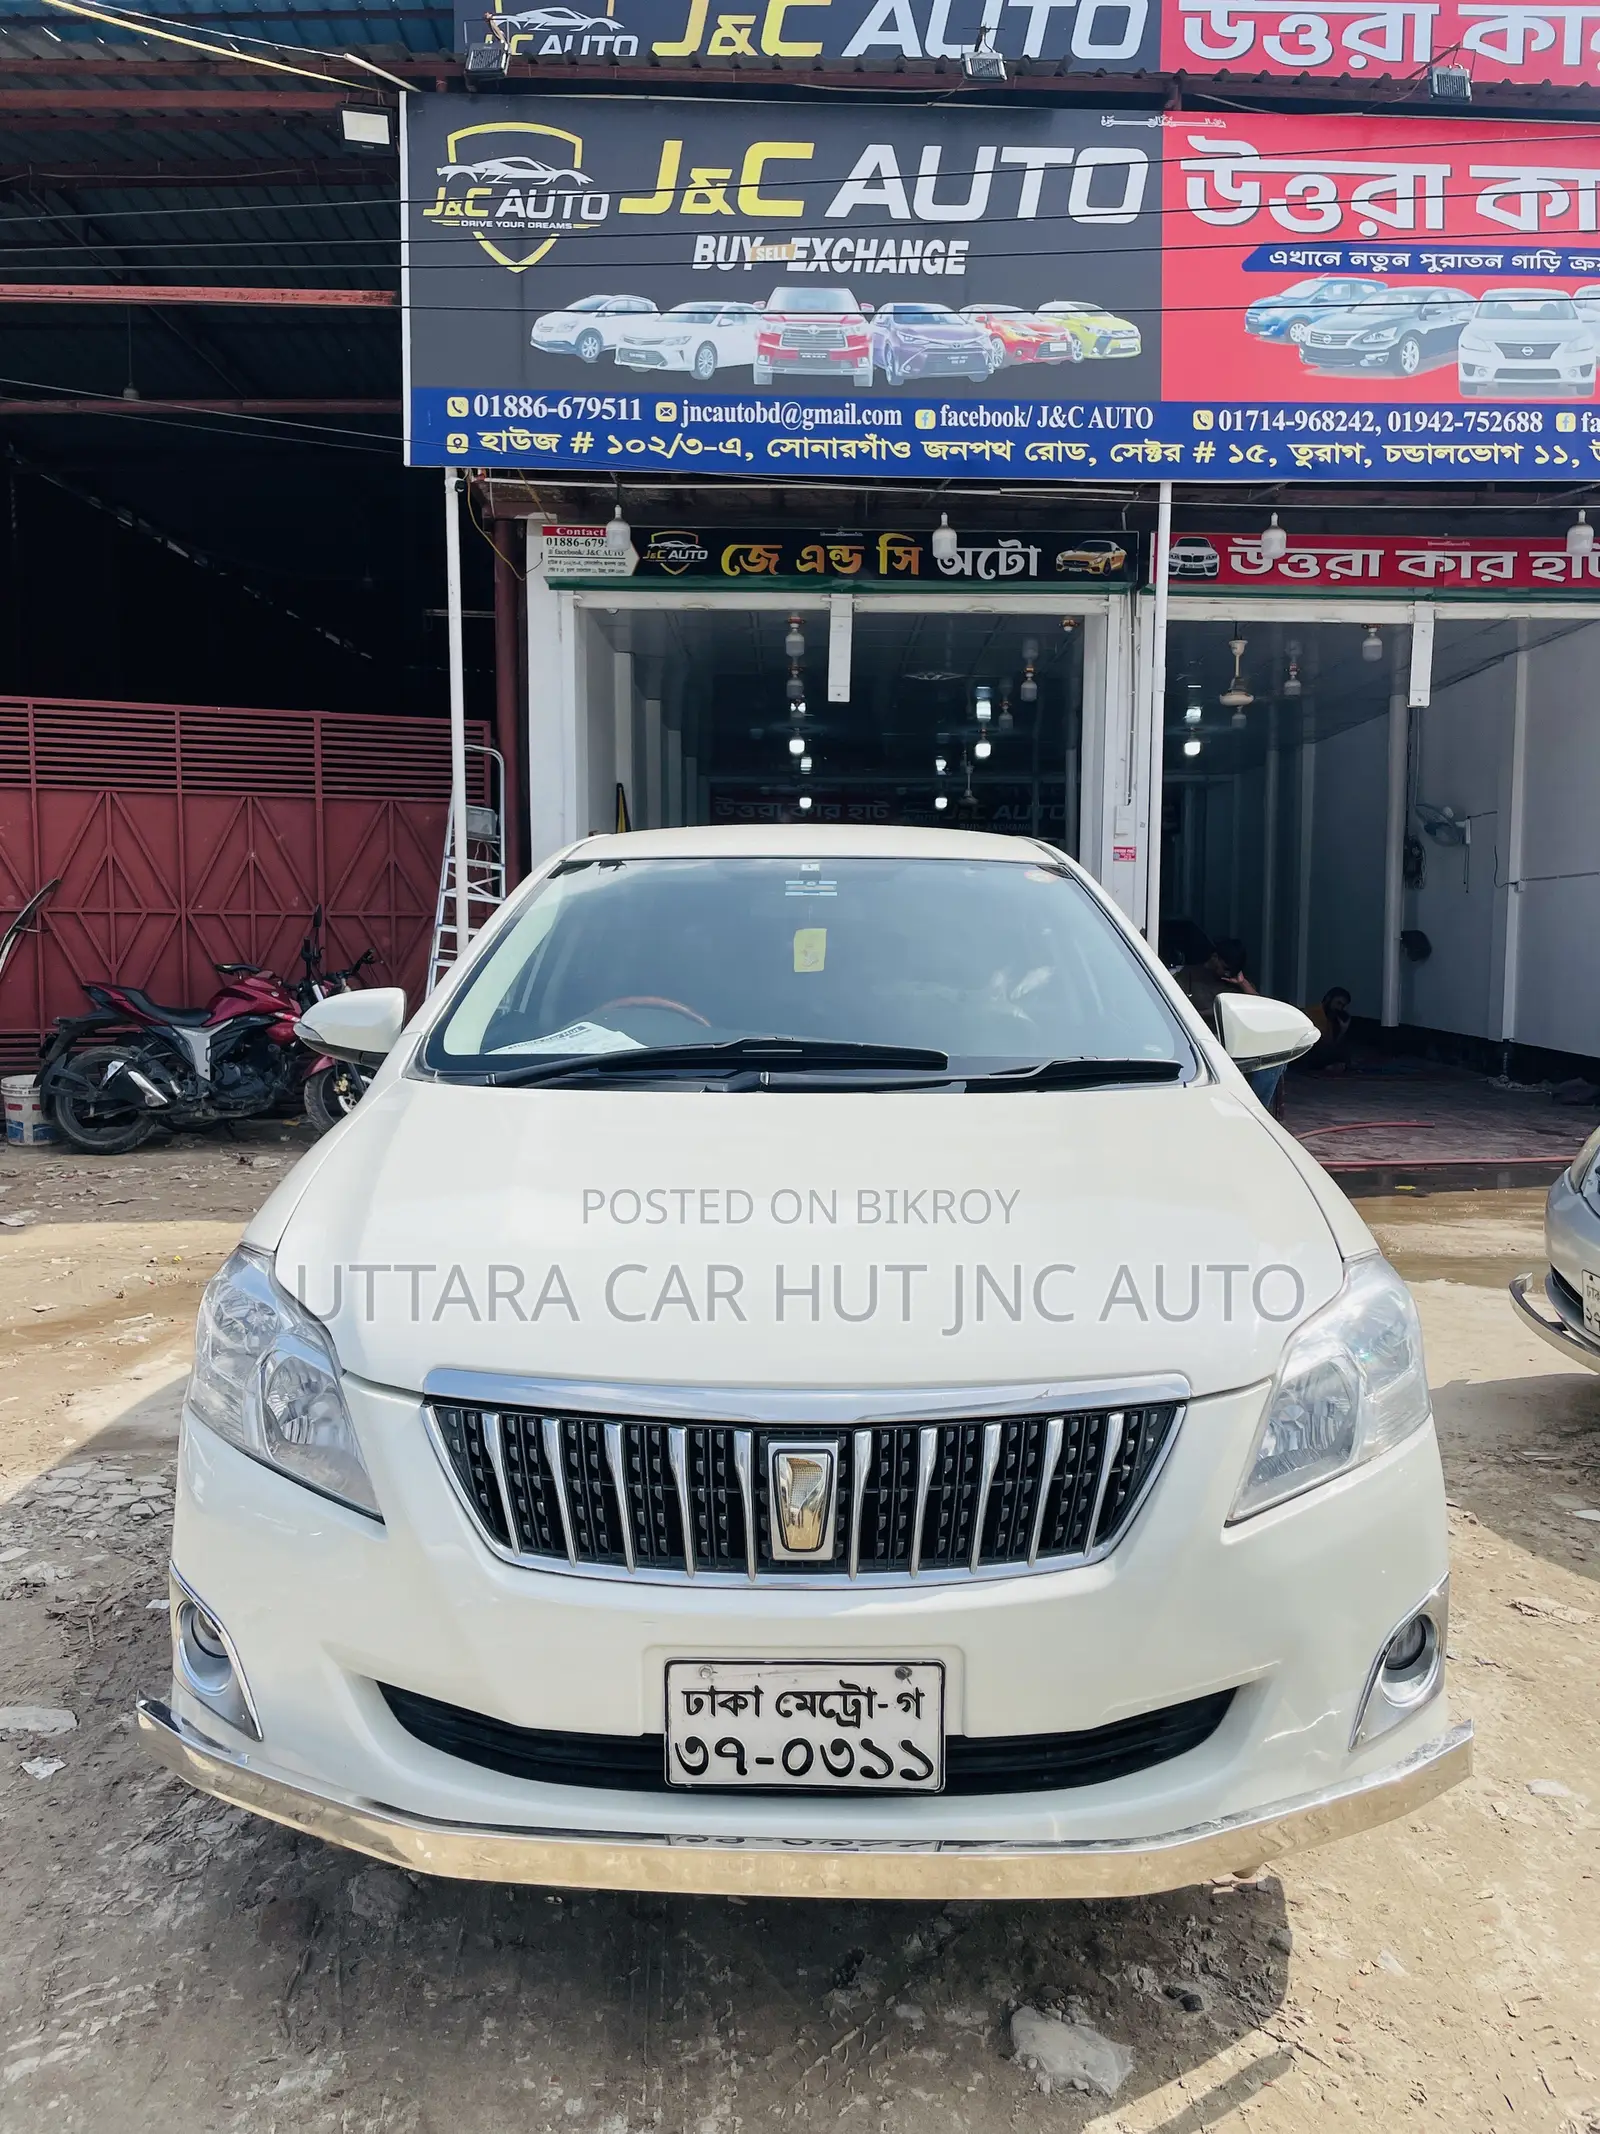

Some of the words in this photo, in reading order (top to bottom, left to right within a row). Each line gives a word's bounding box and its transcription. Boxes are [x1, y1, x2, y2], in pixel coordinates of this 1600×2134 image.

[651, 0, 832, 58] J&C
[841, 0, 1150, 60] AUTO
[619, 139, 816, 218] J&C
[824, 143, 1150, 225] AUTO
[422, 186, 493, 217] J&C
[494, 188, 611, 221] AUTO
[460, 219, 494, 228] DRIVE
[495, 220, 525, 229] YOUR
[527, 222, 573, 230] DREAMS
[692, 234, 765, 272] BUY
[755, 246, 789, 261] SELL
[786, 236, 970, 275] EXCHANGE
[1268, 249, 1342, 268] এখানে
[1348, 250, 1412, 272] নতুন
[1419, 252, 1504, 273] পুরাতন
[1511, 249, 1563, 273] গাড়ি
[1567, 256, 1600, 271] ক্র
[473, 394, 642, 421] 01886-679511
[680, 399, 903, 431] jncautobd@gmail.com
[939, 404, 1033, 430] facebook/
[1036, 405, 1086, 430] J&C
[1087, 405, 1155, 431] AUTO
[1217, 409, 1382, 437] 01714-968242,
[1387, 409, 1544, 434] 01942-752688
[476, 425, 563, 455] হাউজ
[569, 431, 595, 455] #
[920, 440, 1016, 461] জনপথ
[1024, 441, 1098, 467] রোড,
[1192, 440, 1216, 465] #
[1227, 442, 1278, 468] ১৫,
[1286, 442, 1373, 470] তুরাগ,
[1534, 445, 1580, 469] ১১,
[668, 550, 708, 560] AUTO
[721, 544, 783, 577] জে
[876, 532, 923, 576] সি
[937, 539, 1042, 580] অটো
[1395, 549, 1518, 582] কার
[681, 1684, 765, 1719] ঢাকা
[674, 1736, 935, 1781] ৩৭-০৩১১
